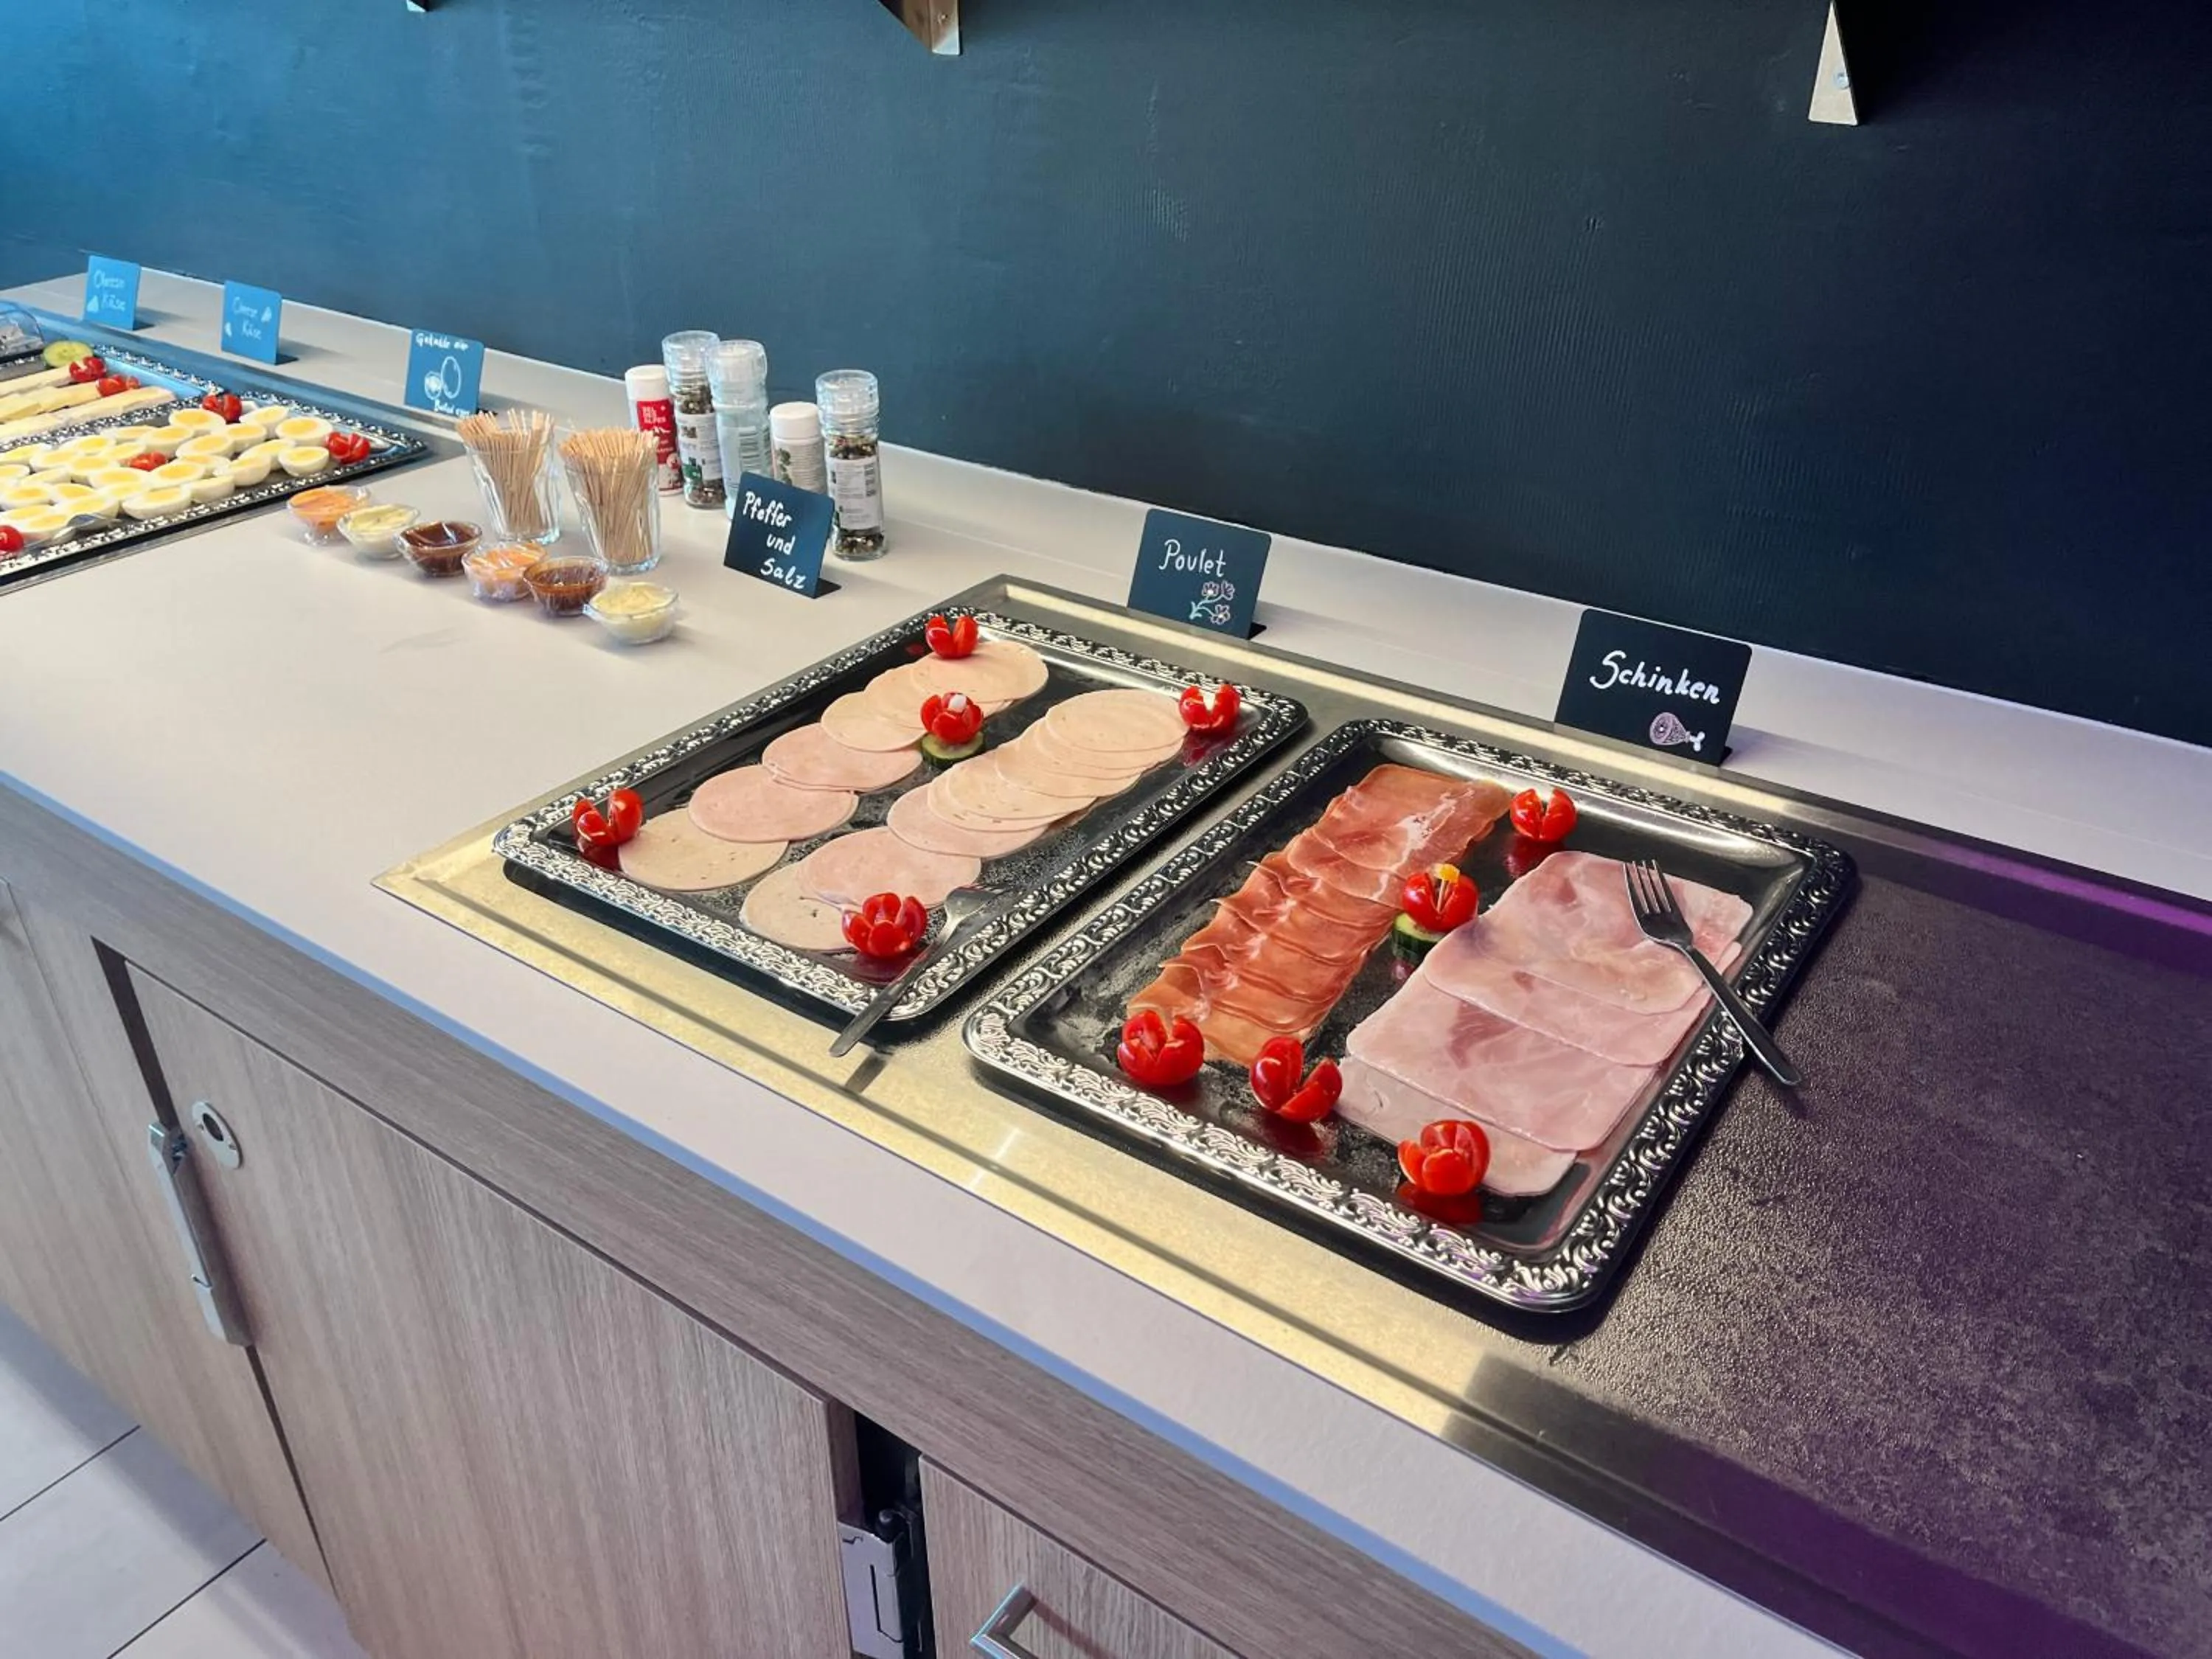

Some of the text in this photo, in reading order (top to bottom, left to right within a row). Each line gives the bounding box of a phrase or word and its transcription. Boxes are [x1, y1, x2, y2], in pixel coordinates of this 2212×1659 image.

[742, 491, 793, 528] Pfeffer
[766, 534, 796, 554] und
[1158, 539, 1226, 577] Poulet
[760, 557, 807, 589] Salz
[1590, 650, 1720, 704] Schinken
